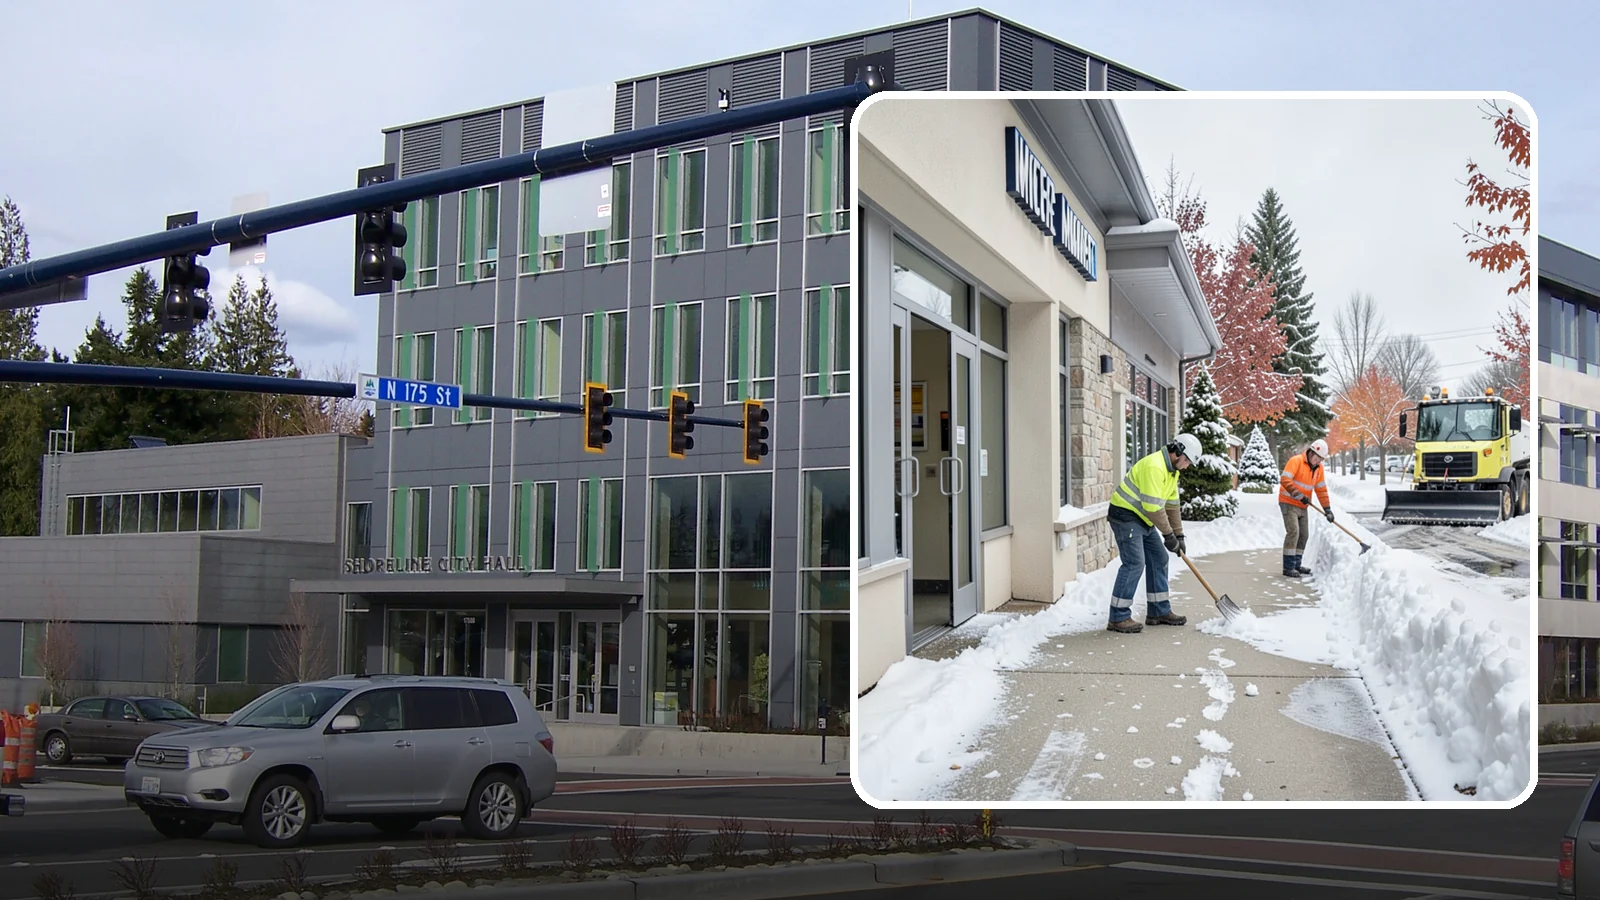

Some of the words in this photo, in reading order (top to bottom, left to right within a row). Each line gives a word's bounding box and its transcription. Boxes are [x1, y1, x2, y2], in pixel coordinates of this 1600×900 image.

[387, 380, 396, 399] N
[405, 382, 427, 403] 175
[436, 386, 451, 406] St
[344, 556, 432, 574] SHORELINE
[438, 556, 475, 572] CITY
[483, 555, 525, 571] HALL
